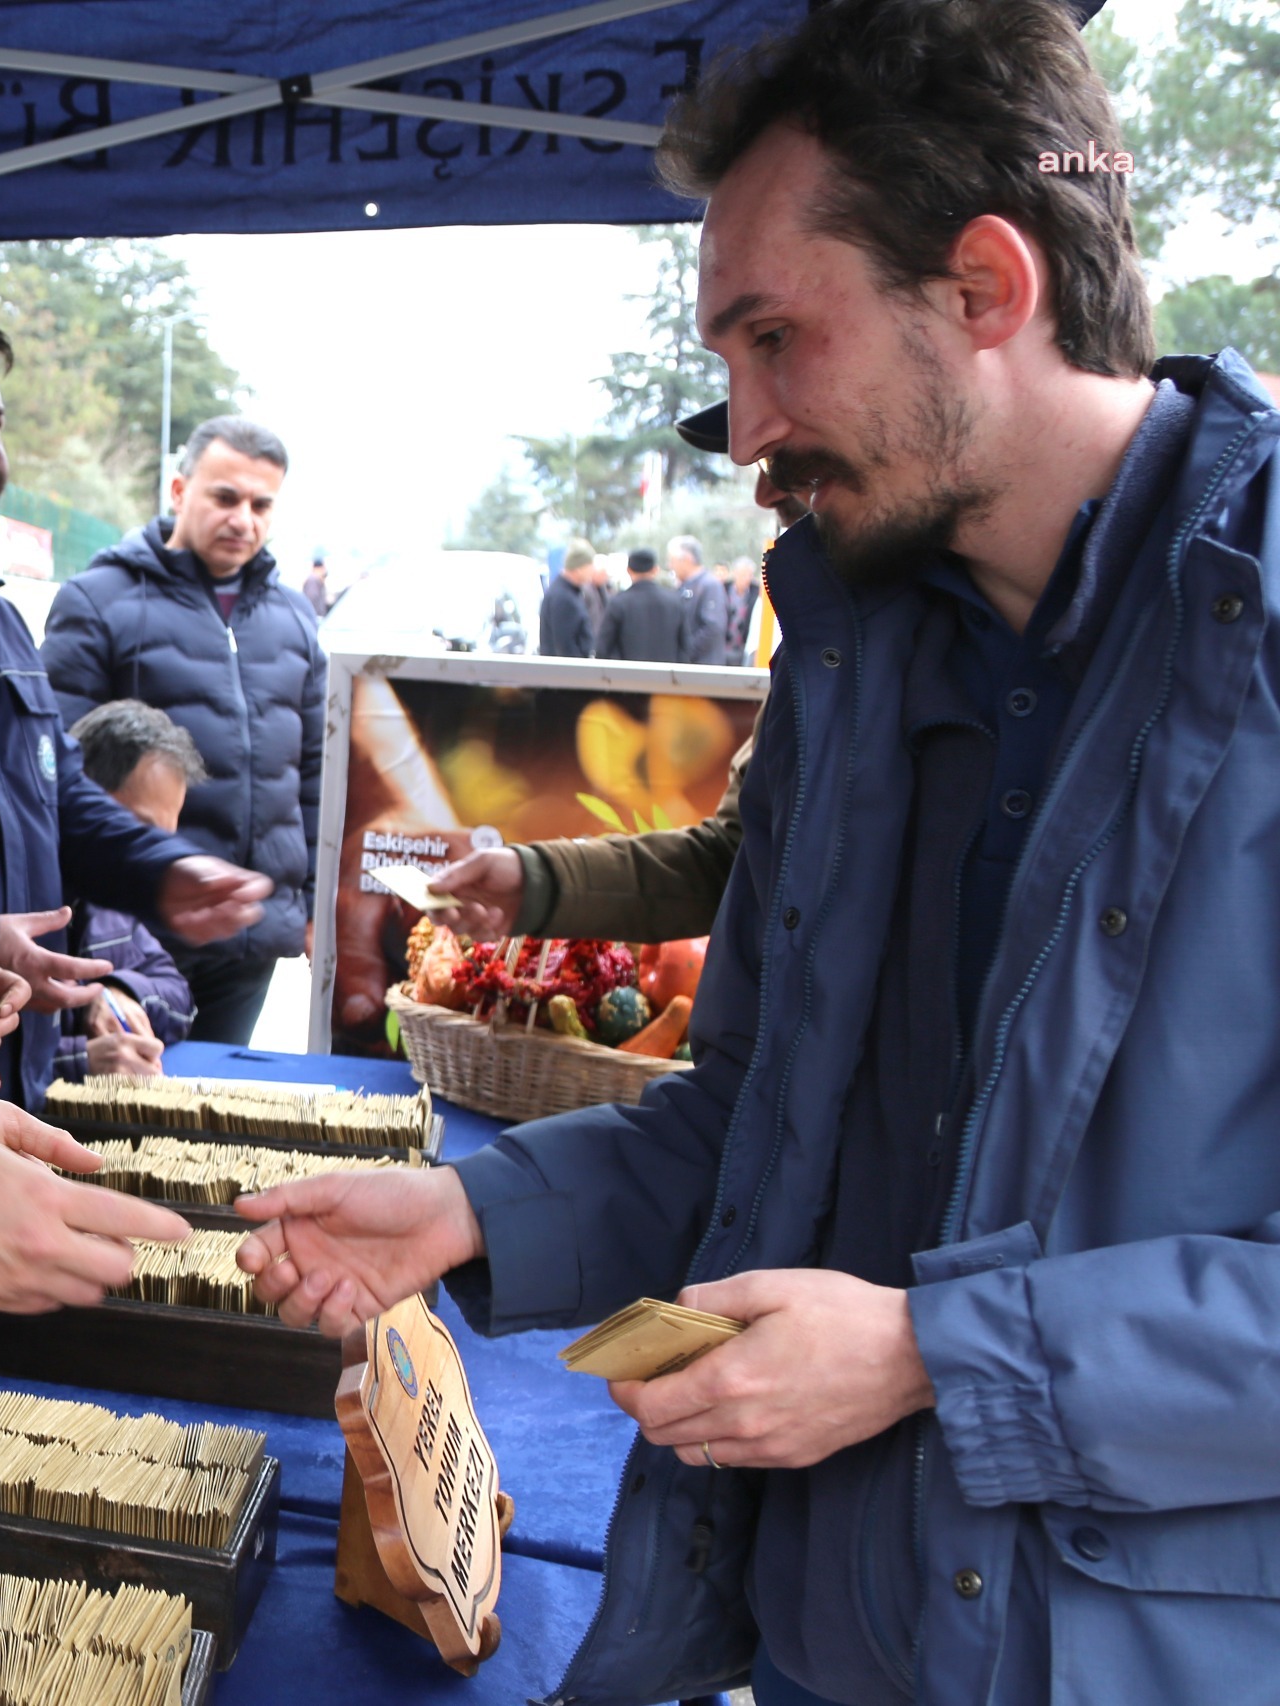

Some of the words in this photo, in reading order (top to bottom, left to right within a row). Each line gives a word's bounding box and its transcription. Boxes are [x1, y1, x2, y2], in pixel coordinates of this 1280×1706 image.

[363, 830, 449, 857] Eskişehir
[412, 1378, 443, 1472] YEREL
[433, 1411, 463, 1526] TOHUM
[450, 1426, 486, 1599] MERKEZİ
